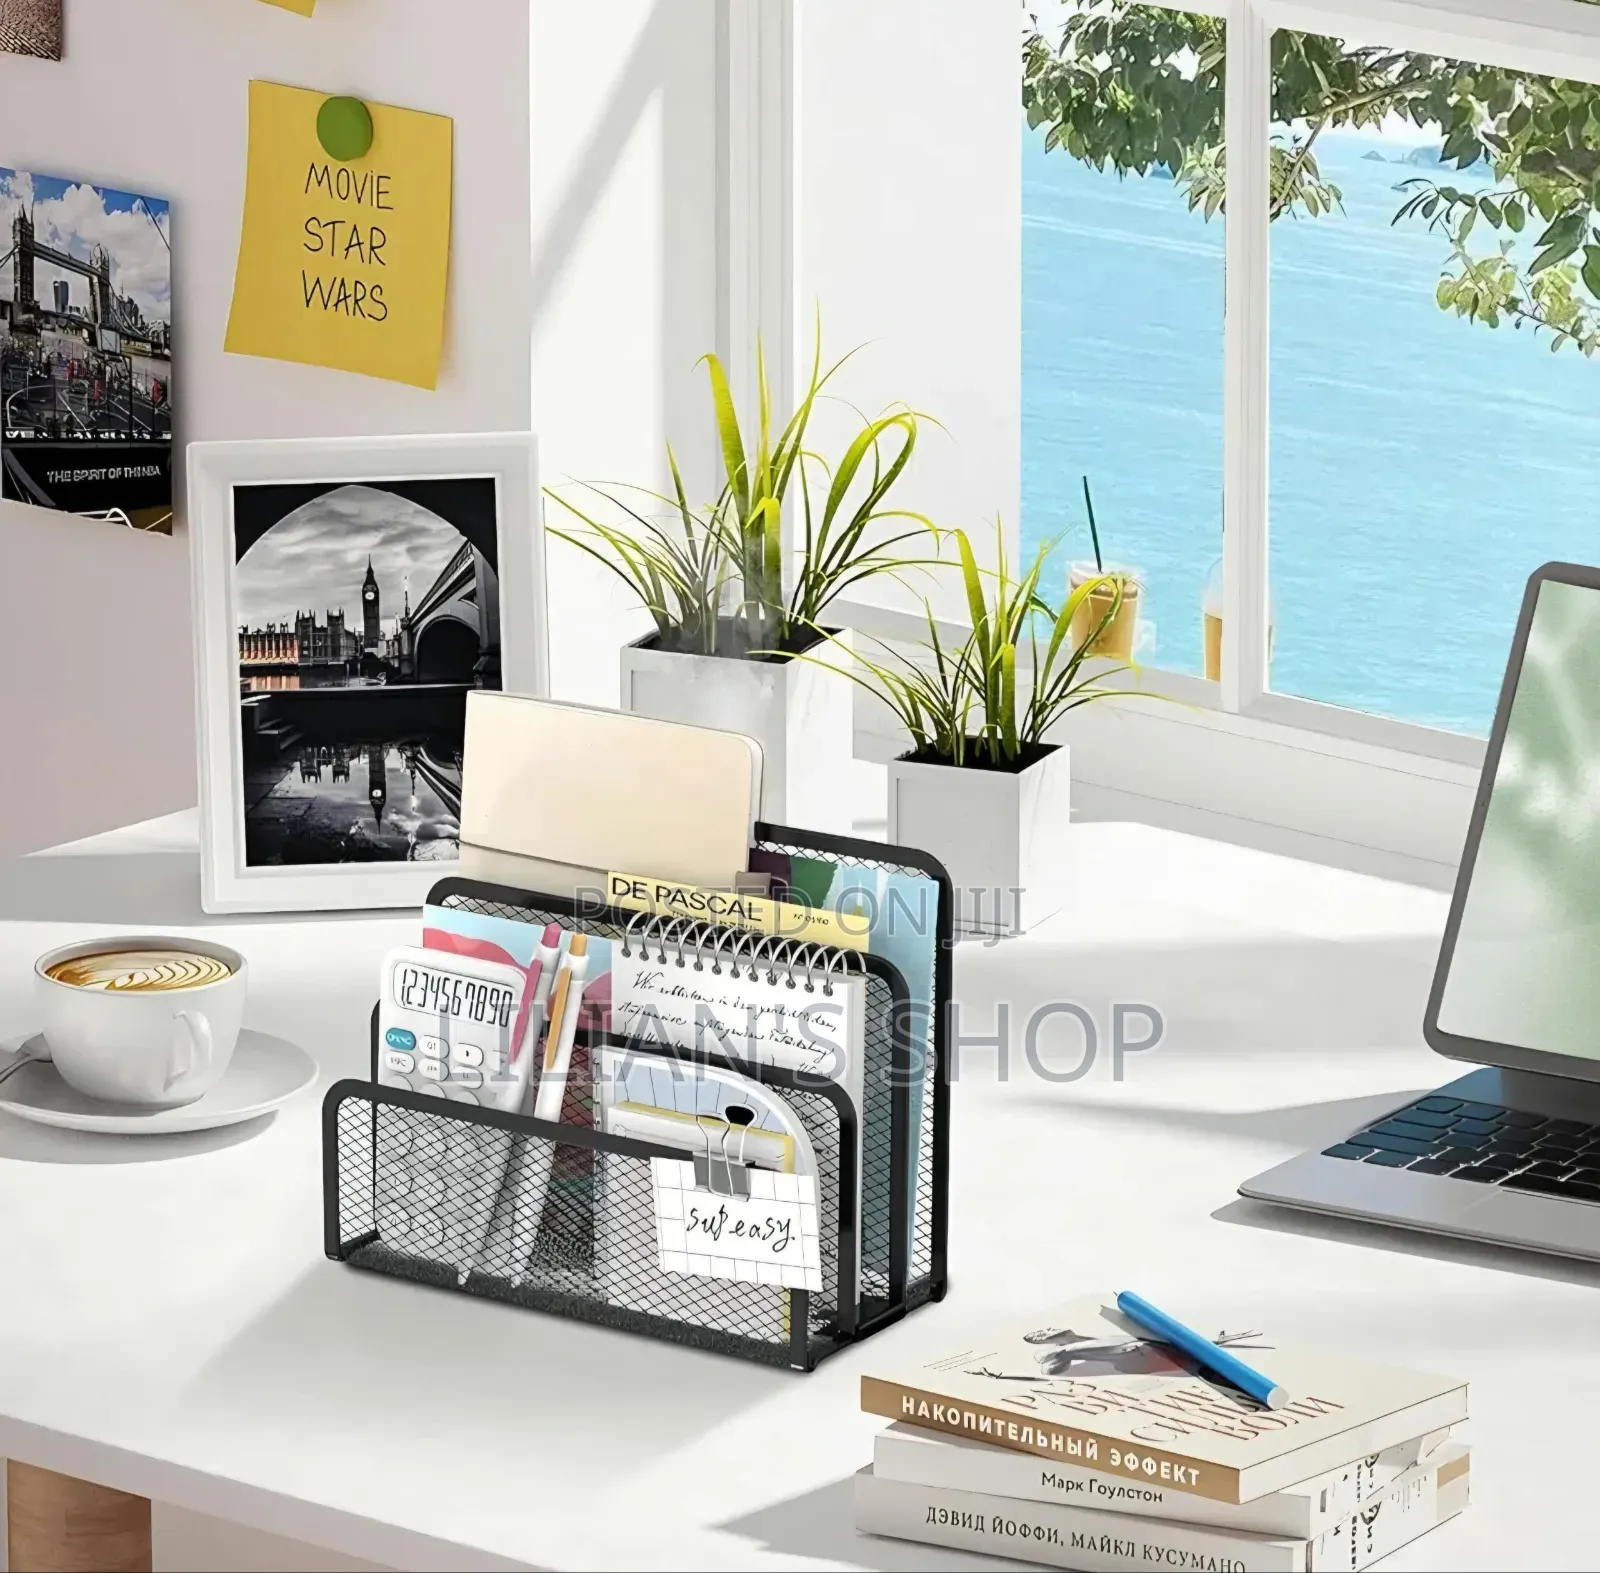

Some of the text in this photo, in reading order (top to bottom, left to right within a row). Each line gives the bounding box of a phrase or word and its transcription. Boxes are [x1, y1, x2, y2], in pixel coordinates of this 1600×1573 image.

[305, 162, 393, 210] MOVIE
[303, 217, 387, 266] STAR
[302, 270, 389, 322] WARS
[612, 877, 648, 900] DE
[655, 885, 762, 922] PASCAL
[401, 968, 513, 1028] 1234567890
[902, 1395, 1201, 1487] НАКОПИТЕЛЬНЫЙ ЭФФЕКТ
[1041, 1471, 1163, 1503] Марк Гоулстон
[925, 1506, 1247, 1573] ДЭВИД ЙОФФИ, МАЙКЛ КУСУМАНО
